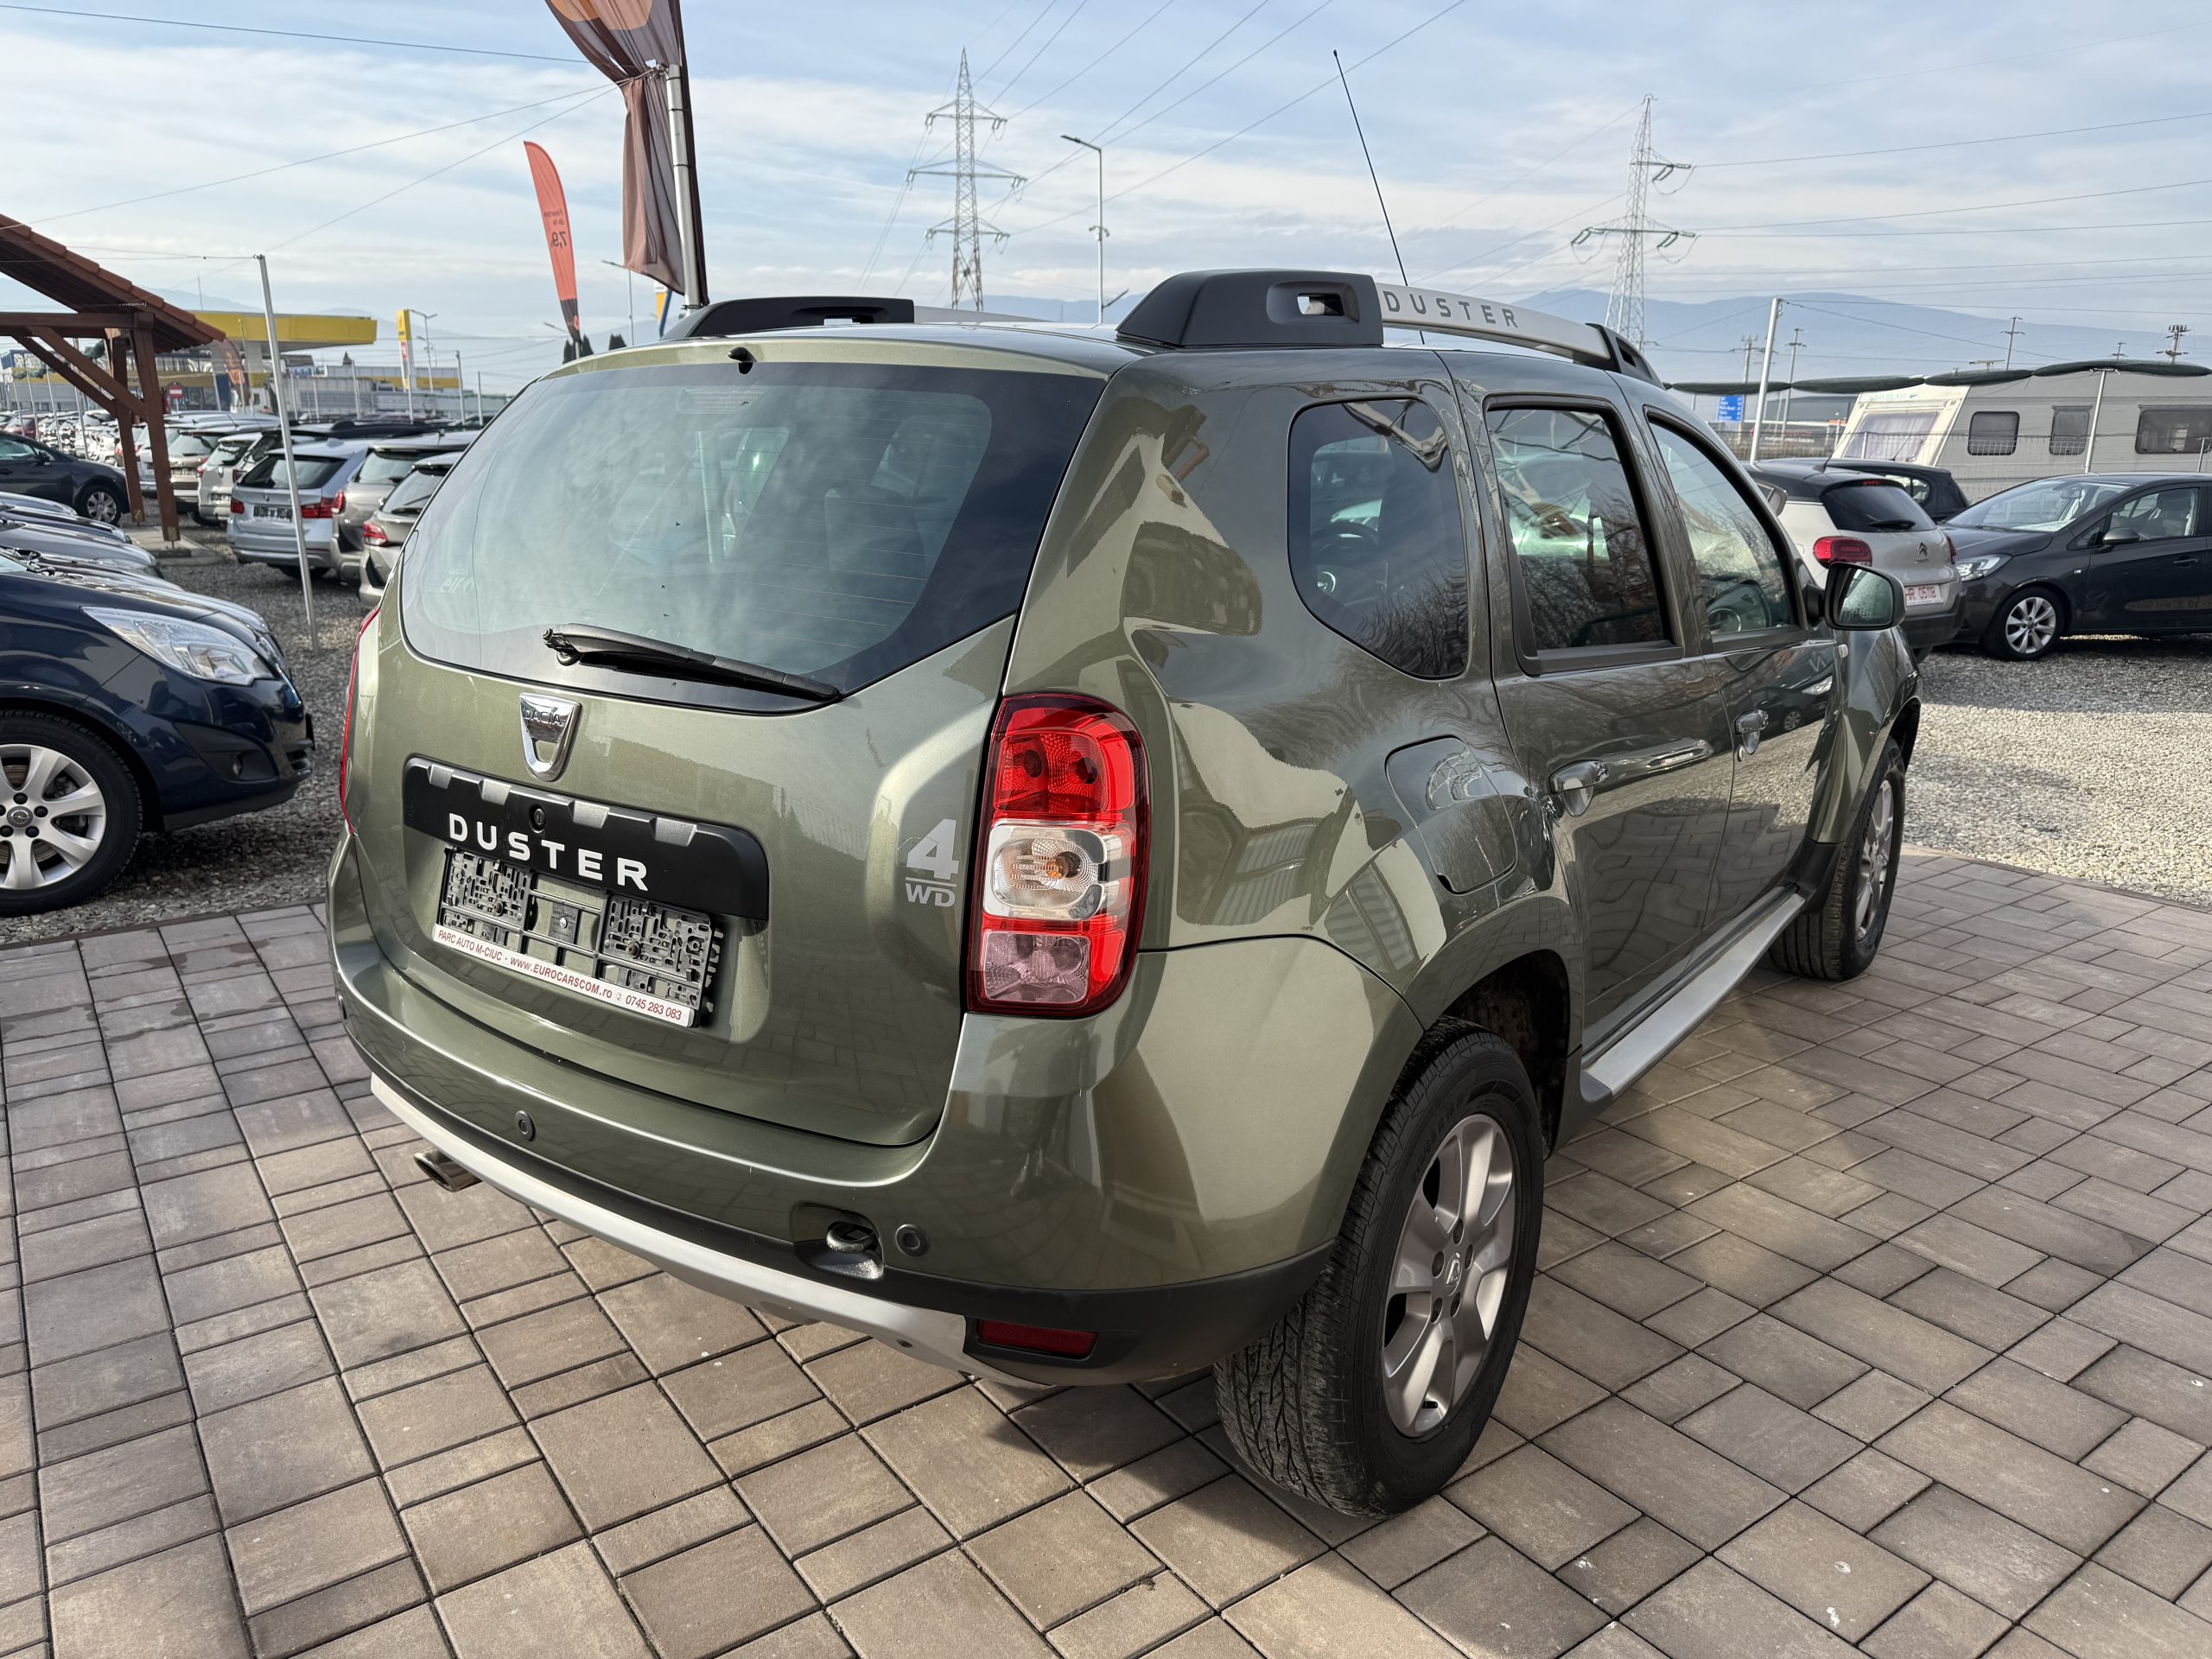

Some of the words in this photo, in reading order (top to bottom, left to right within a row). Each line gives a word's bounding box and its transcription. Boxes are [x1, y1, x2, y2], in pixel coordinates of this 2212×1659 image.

[1382, 290, 1518, 328] DUSTER
[448, 812, 648, 892] DUSTER
[906, 818, 960, 880] 4
[905, 882, 956, 907] WD
[438, 930, 456, 944] PARC
[456, 937, 475, 951] AUTO
[475, 943, 503, 961] M-CIUC
[626, 995, 646, 1009] 0745
[648, 1001, 664, 1015] 283
[665, 1007, 682, 1020] 083
